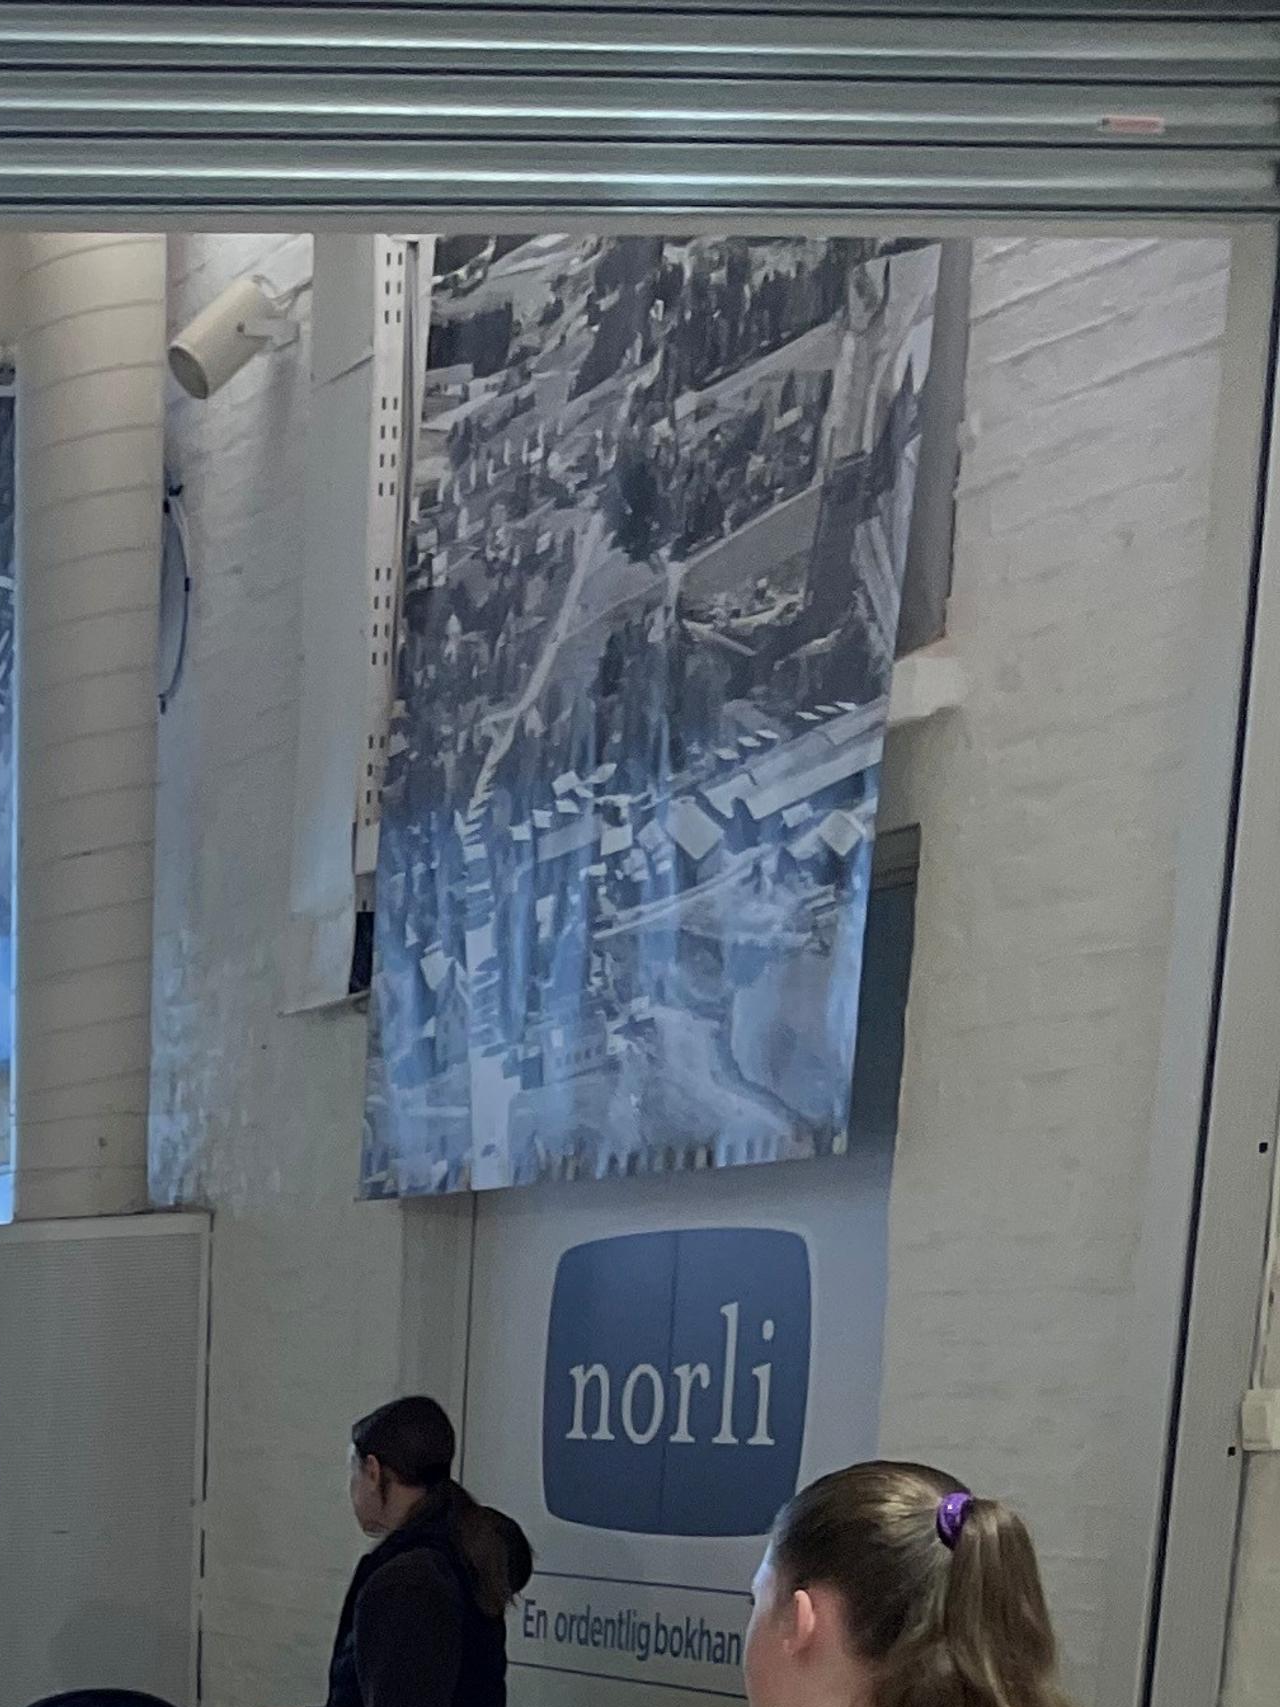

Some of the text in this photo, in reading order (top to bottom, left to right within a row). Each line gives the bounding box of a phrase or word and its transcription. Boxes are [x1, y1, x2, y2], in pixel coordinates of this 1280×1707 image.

[565, 1301, 775, 1445] norli
[523, 1599, 741, 1666] En ordentlig bokhan
